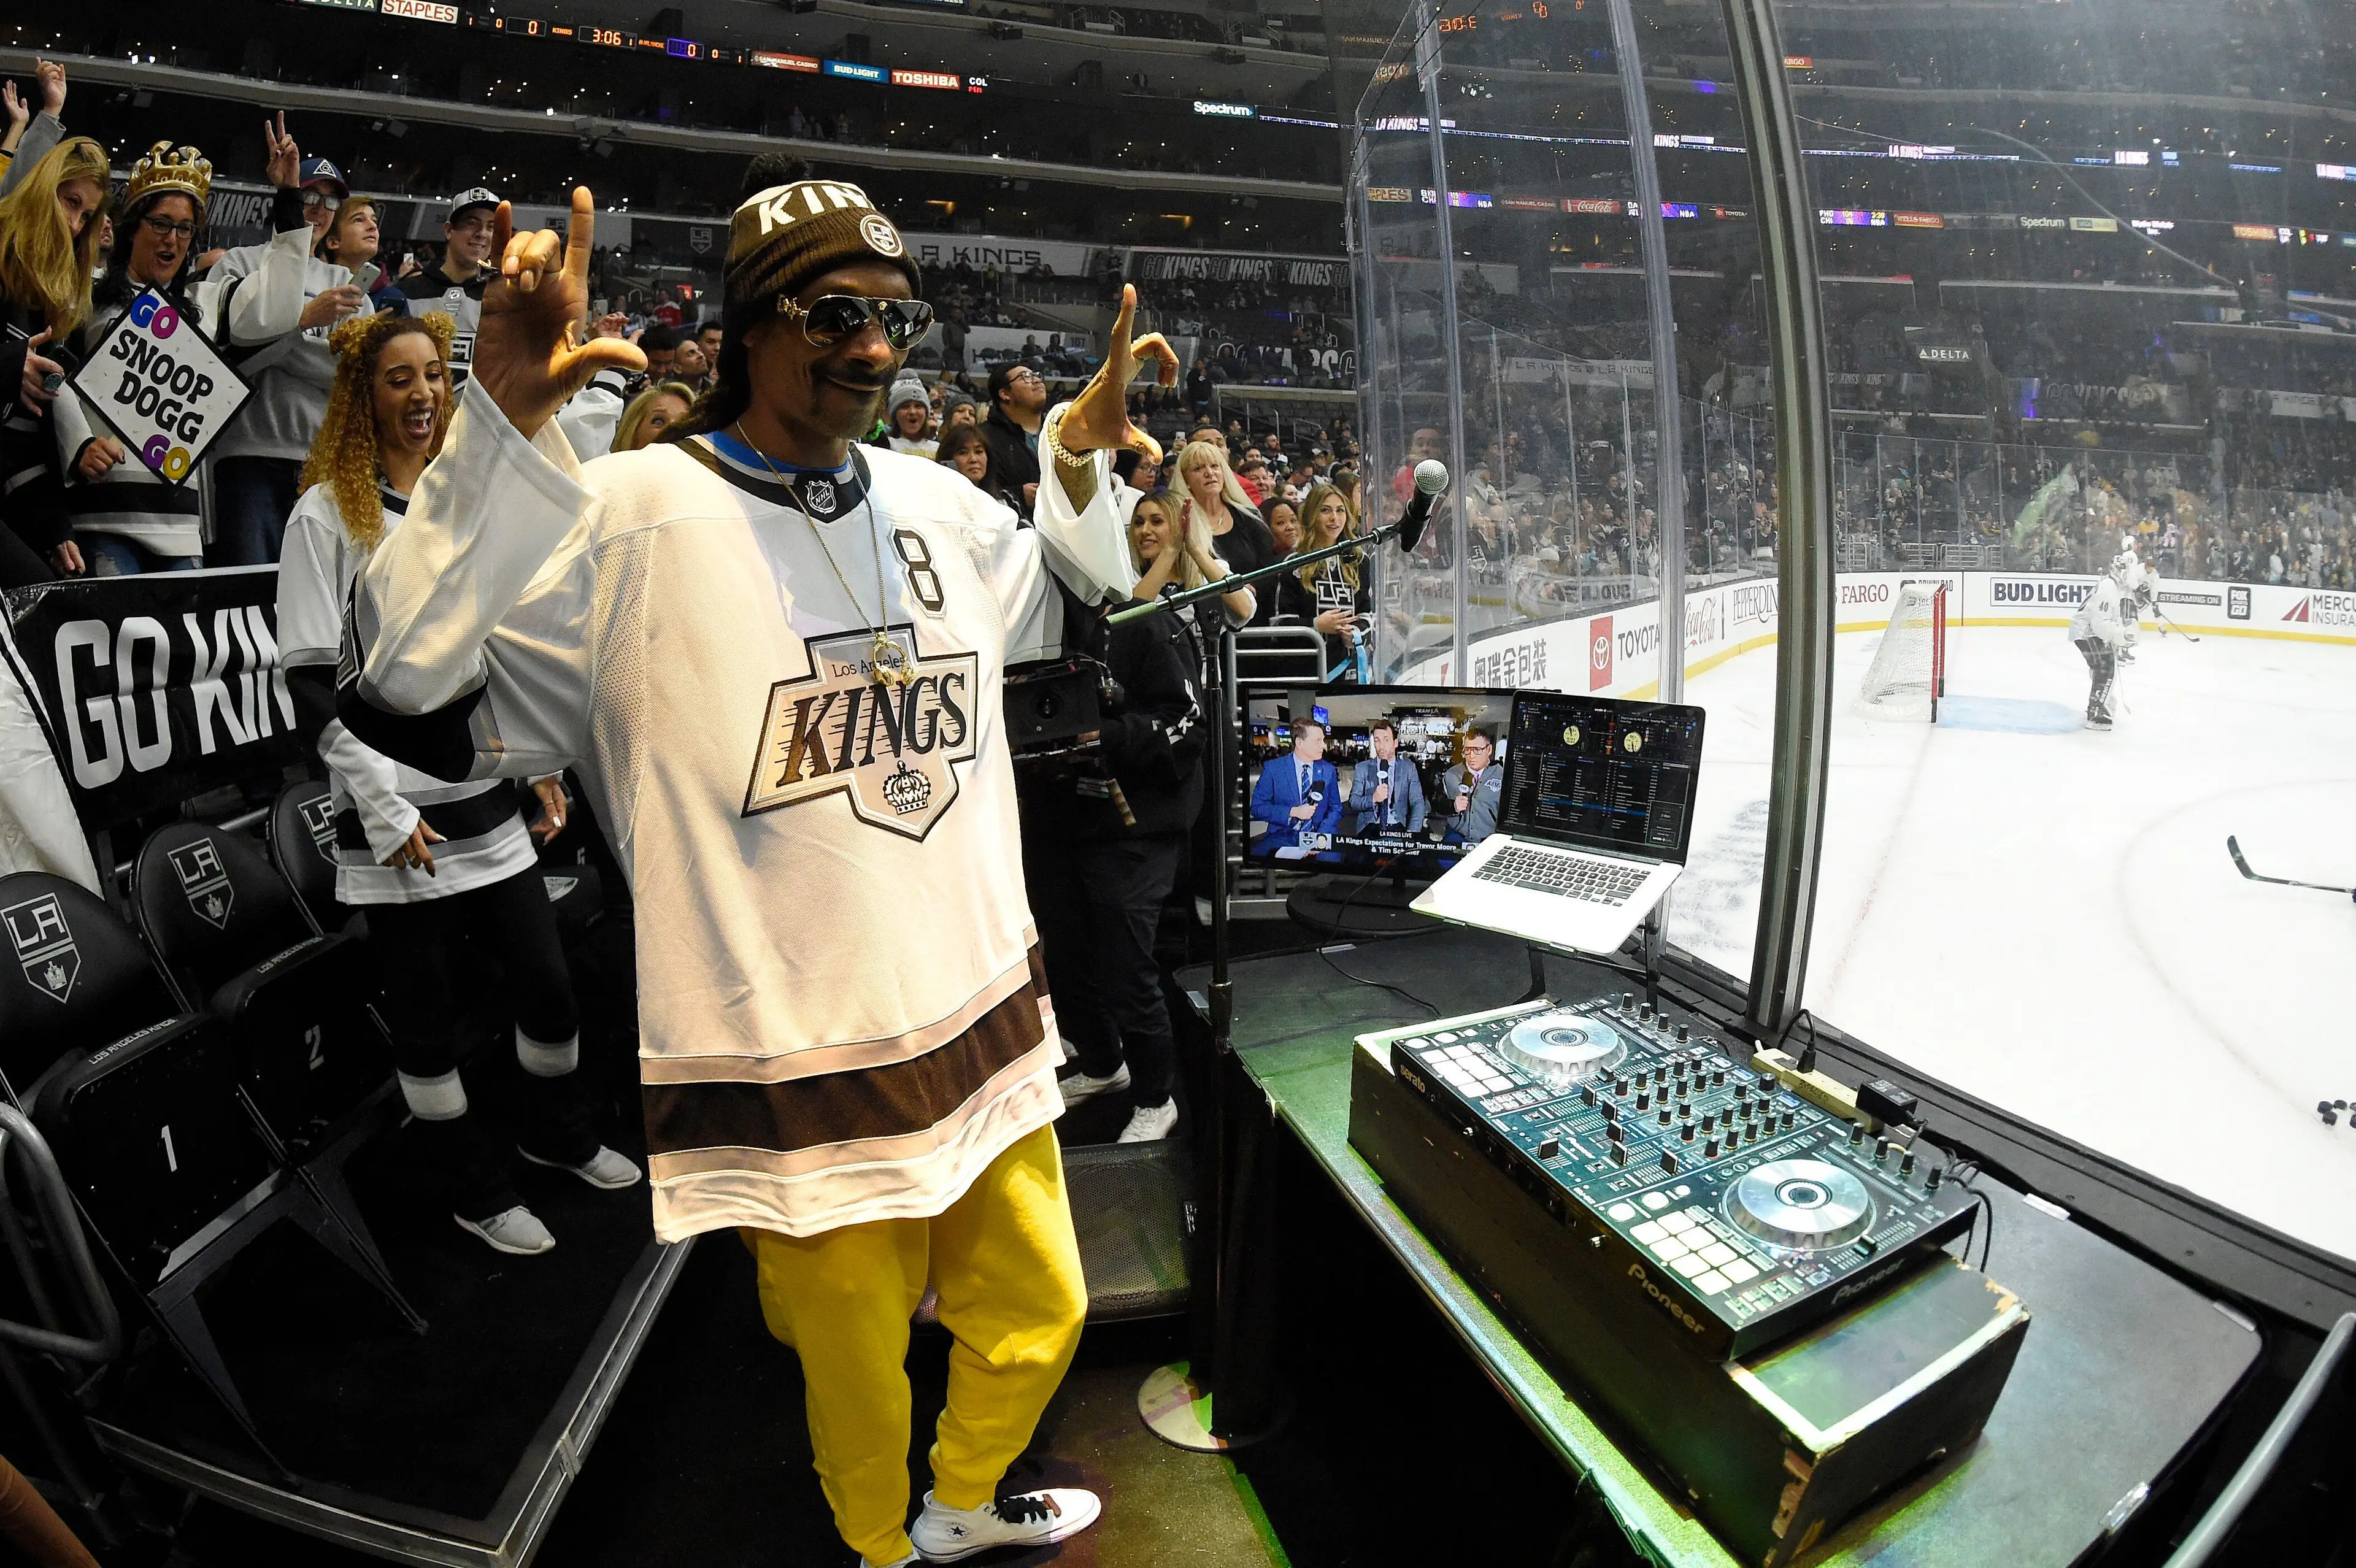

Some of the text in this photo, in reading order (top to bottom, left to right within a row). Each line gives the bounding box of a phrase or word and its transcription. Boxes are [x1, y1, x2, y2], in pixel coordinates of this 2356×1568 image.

[383, 0, 455, 22] STAPLES
[496, 18, 502, 28] 0
[528, 21, 537, 34] 0
[592, 29, 621, 45] 3:06
[687, 44, 696, 57] 0
[712, 48, 718, 59] 0
[834, 64, 879, 79] BUD LIGHT
[893, 72, 959, 88] TOSHIBA
[969, 77, 988, 86] COL
[1193, 101, 1250, 116] Spectrum
[1375, 117, 1419, 131] LA KINGS
[1653, 134, 1680, 148] KINGS
[2020, 217, 2065, 229] Spectrum
[952, 246, 1042, 267] KINGS
[1163, 255, 1210, 280] KINGS
[1290, 263, 1332, 286] KINGS
[130, 294, 179, 339] GO
[1931, 348, 1969, 359] DELTA
[109, 329, 214, 405] SNOOP
[114, 372, 204, 445] DOGG
[142, 434, 191, 481] GO
[814, 488, 832, 505] NHL
[893, 526, 945, 615] 8
[1841, 583, 1888, 604] FARGO
[1994, 583, 2034, 601] BUD
[2160, 593, 2219, 605] STREAMING ON
[2231, 590, 2248, 601] FOX
[2098, 601, 2109, 613] 40
[2231, 605, 2247, 615] GO
[1618, 624, 1660, 661] TOYOTA
[831, 664, 858, 678] Los
[55, 616, 172, 790] GO
[776, 672, 967, 788] KINGS
[1364, 838, 1404, 848] Expectations
[174, 845, 221, 882] LA
[7, 902, 66, 950] LA
[256, 961, 274, 974] LOS
[88, 1018, 178, 1065] LOS ANGELES KINGS
[305, 1024, 325, 1071] 2
[1399, 1063, 1426, 1094] serato
[161, 1124, 177, 1172] 1
[1627, 1264, 1706, 1334] Pioneer
